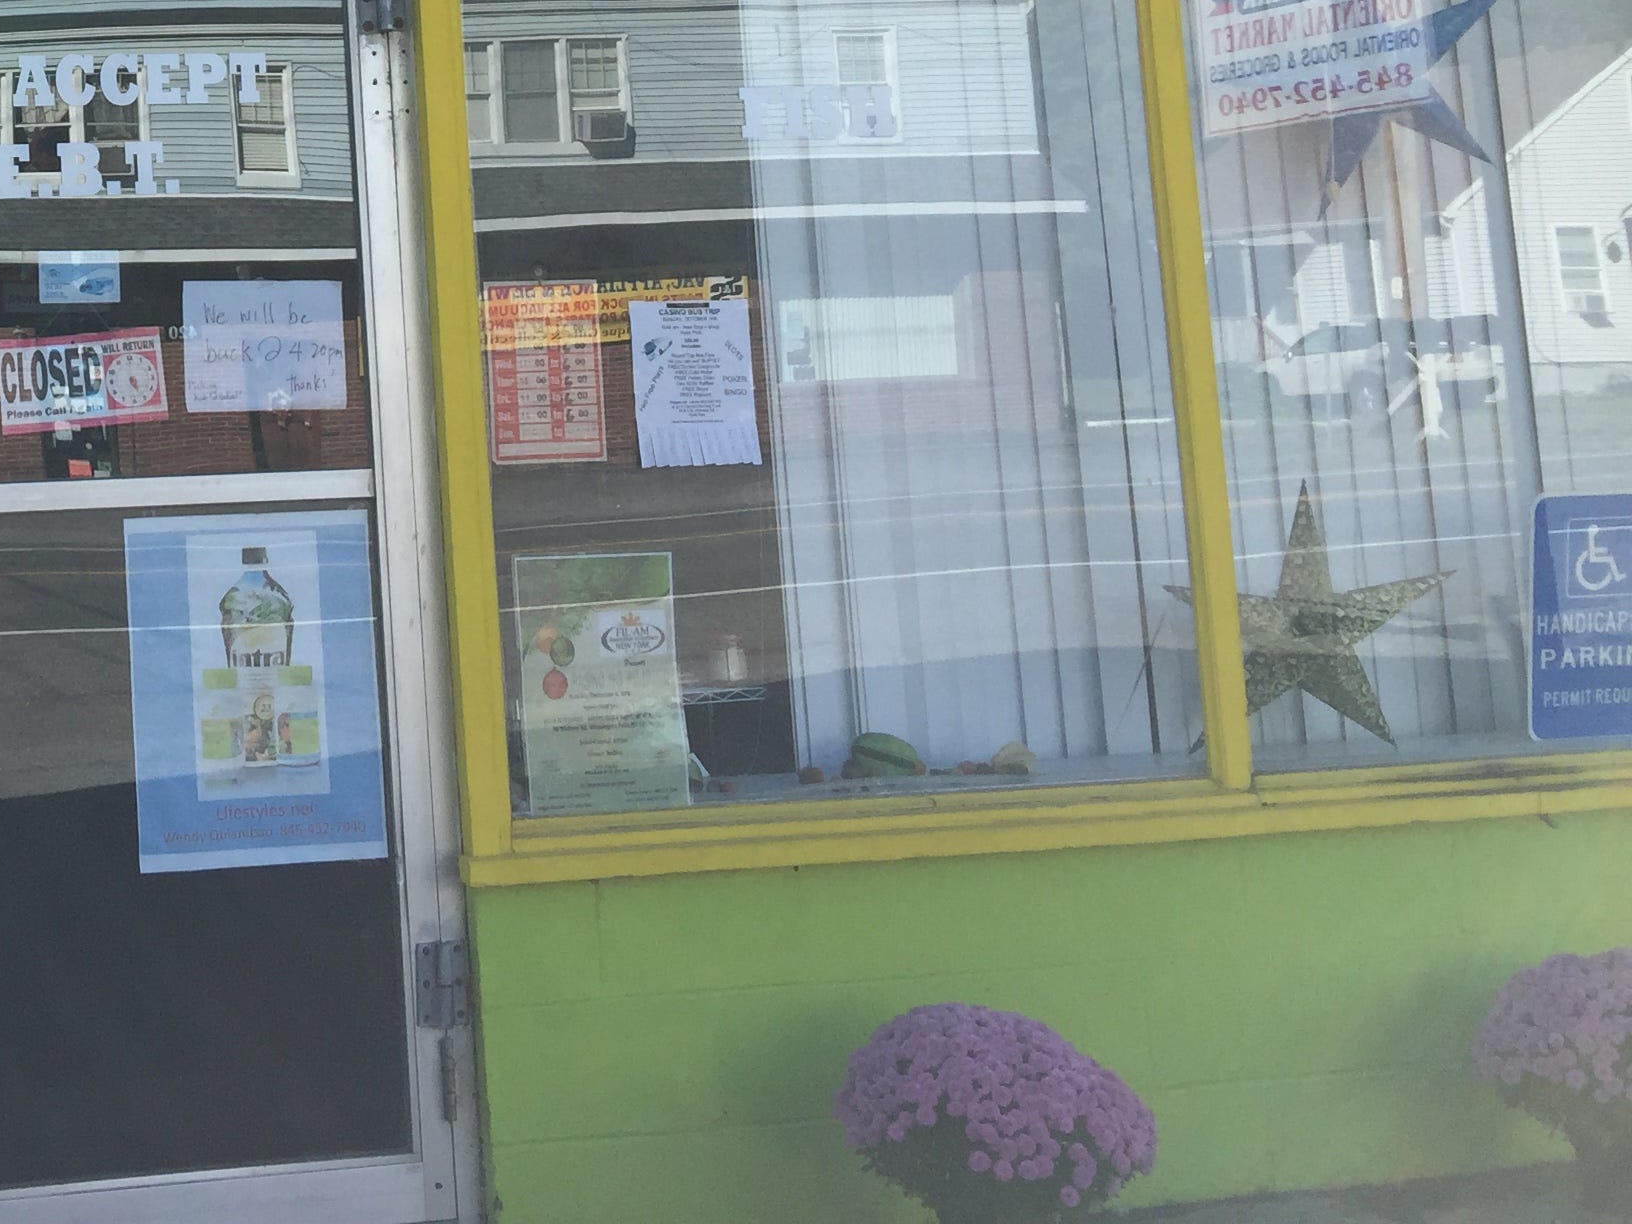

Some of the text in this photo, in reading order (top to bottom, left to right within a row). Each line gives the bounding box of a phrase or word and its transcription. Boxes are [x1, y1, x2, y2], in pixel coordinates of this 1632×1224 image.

[13, 52, 267, 107] ACCEPT
[203, 302, 313, 325] We will be
[101, 339, 154, 354] WILL RETURN
[204, 338, 253, 363] back
[0, 346, 103, 404] CLOSED
[6, 408, 43, 421] Please
[45, 405, 67, 417] Call
[1543, 689, 1591, 708] PERMIT
